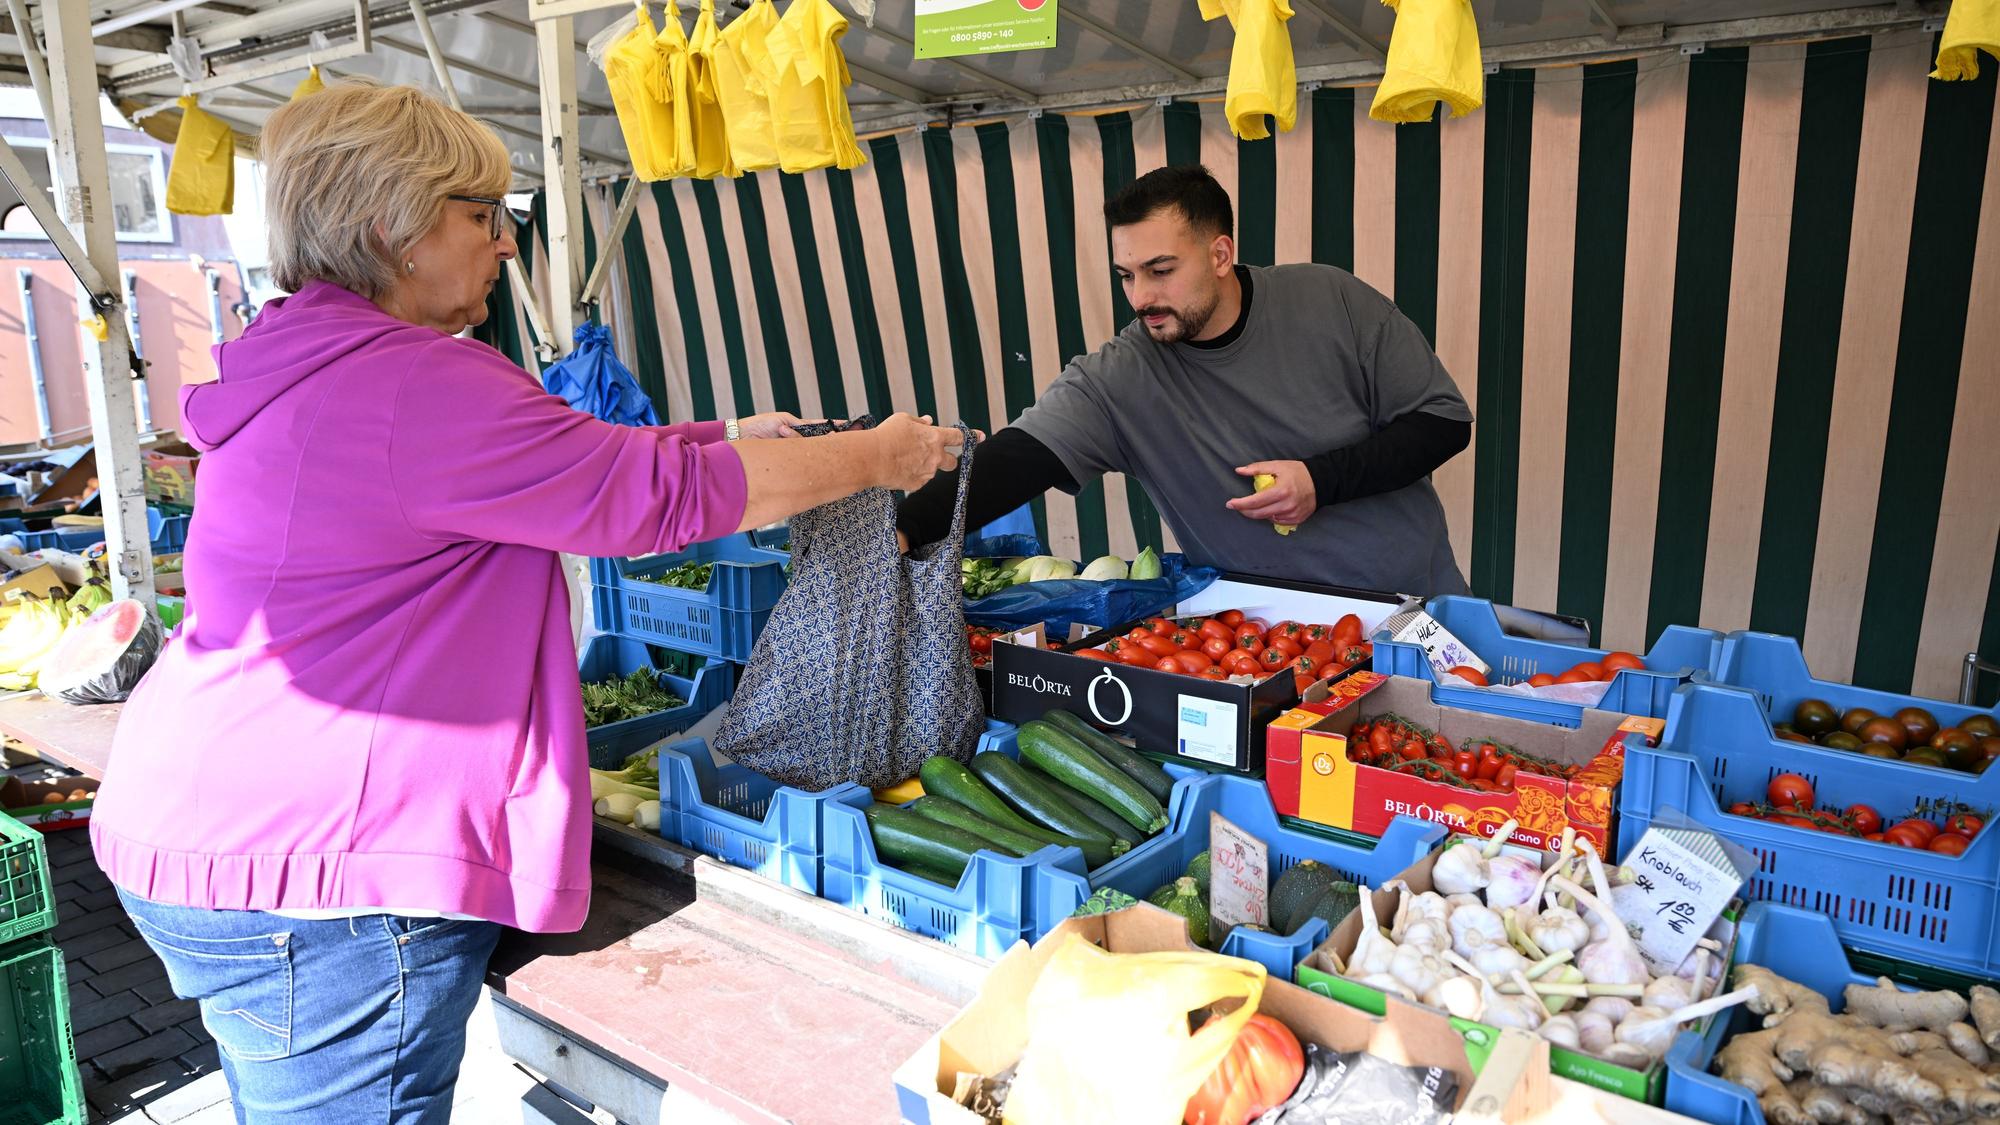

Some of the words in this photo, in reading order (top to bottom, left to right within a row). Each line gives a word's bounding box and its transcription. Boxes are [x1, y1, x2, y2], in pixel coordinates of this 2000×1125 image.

[950, 33, 971, 42] 0800
[972, 30, 992, 42] 5890
[999, 29, 1014, 38] 140
[1638, 845, 1703, 895] Knoblauch
